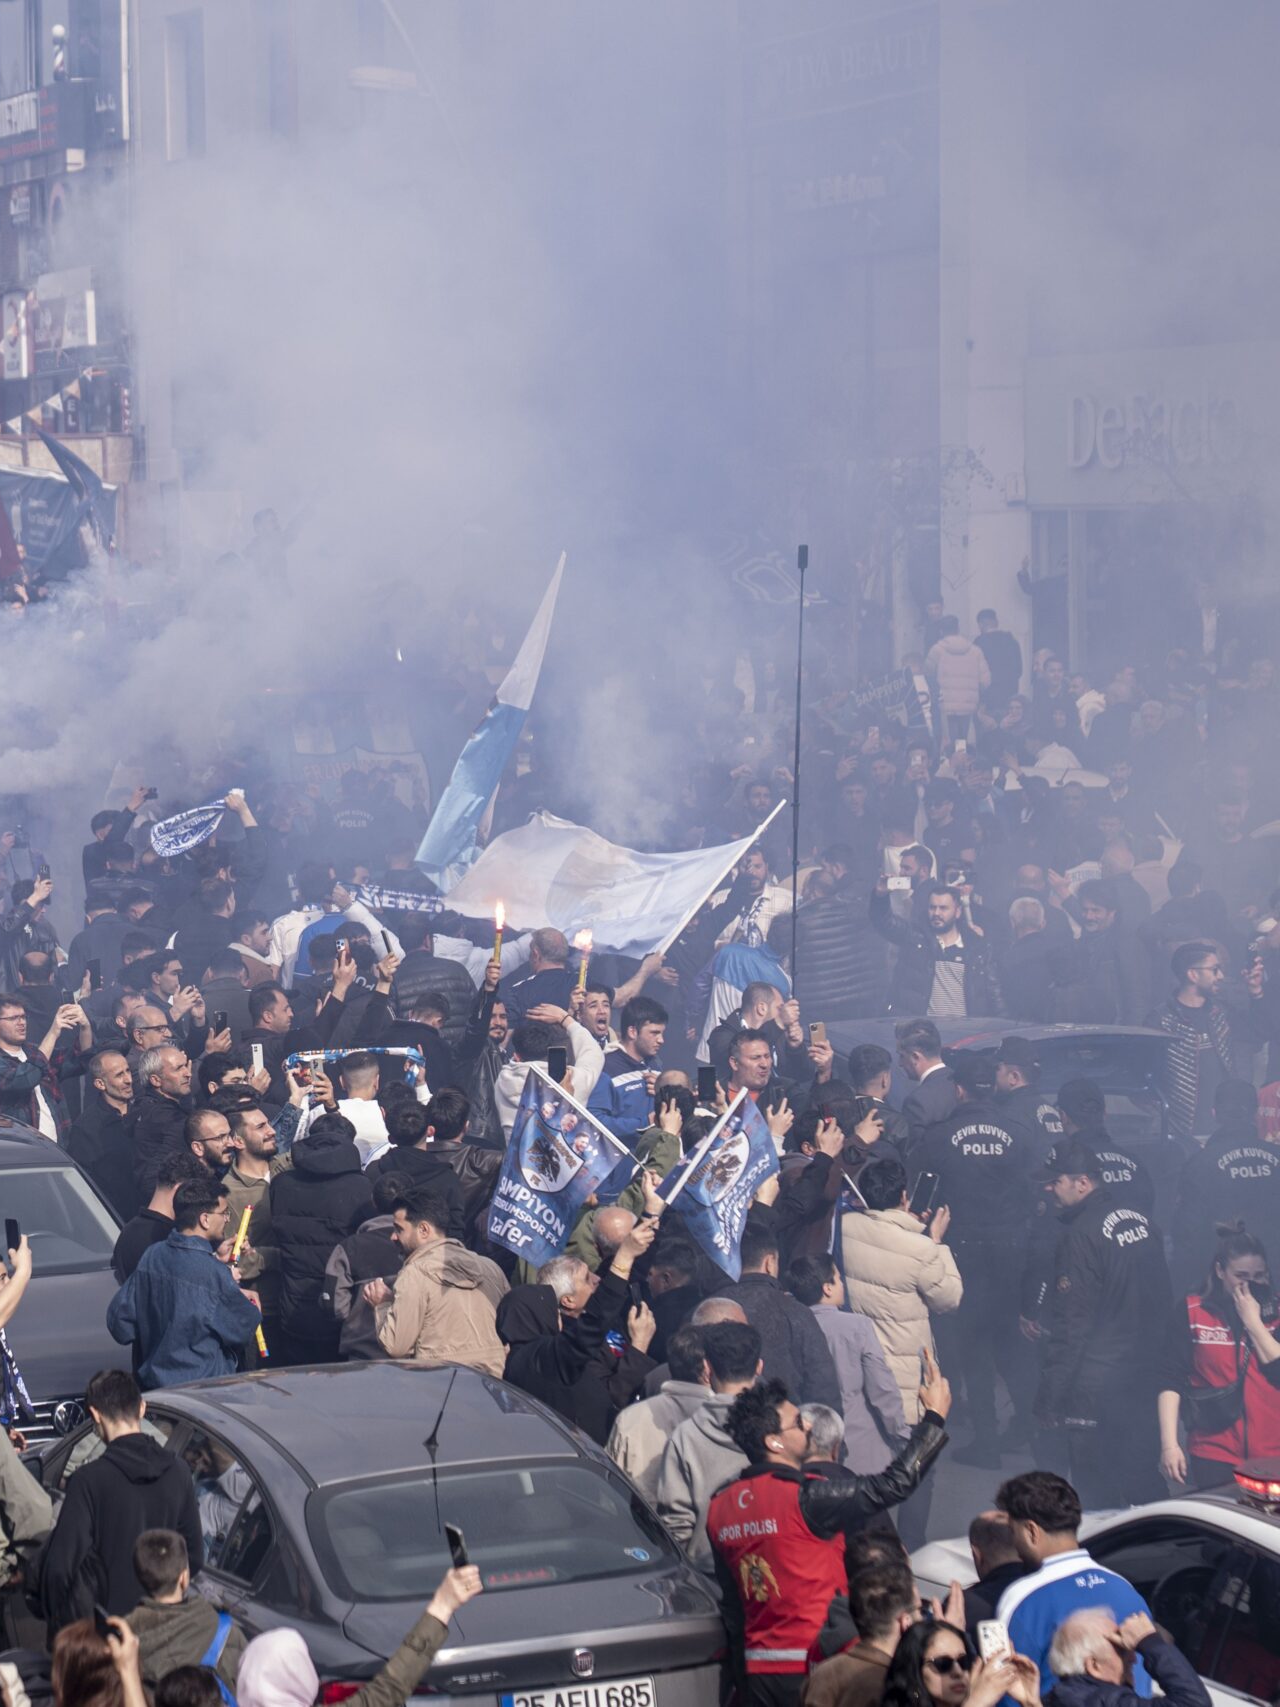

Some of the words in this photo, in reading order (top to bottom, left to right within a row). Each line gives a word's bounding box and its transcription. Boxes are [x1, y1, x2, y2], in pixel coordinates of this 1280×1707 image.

[978, 1124, 1013, 1147] KUVVET
[1199, 1329, 1229, 1342] SPOR
[605, 1682, 652, 1707] 685
